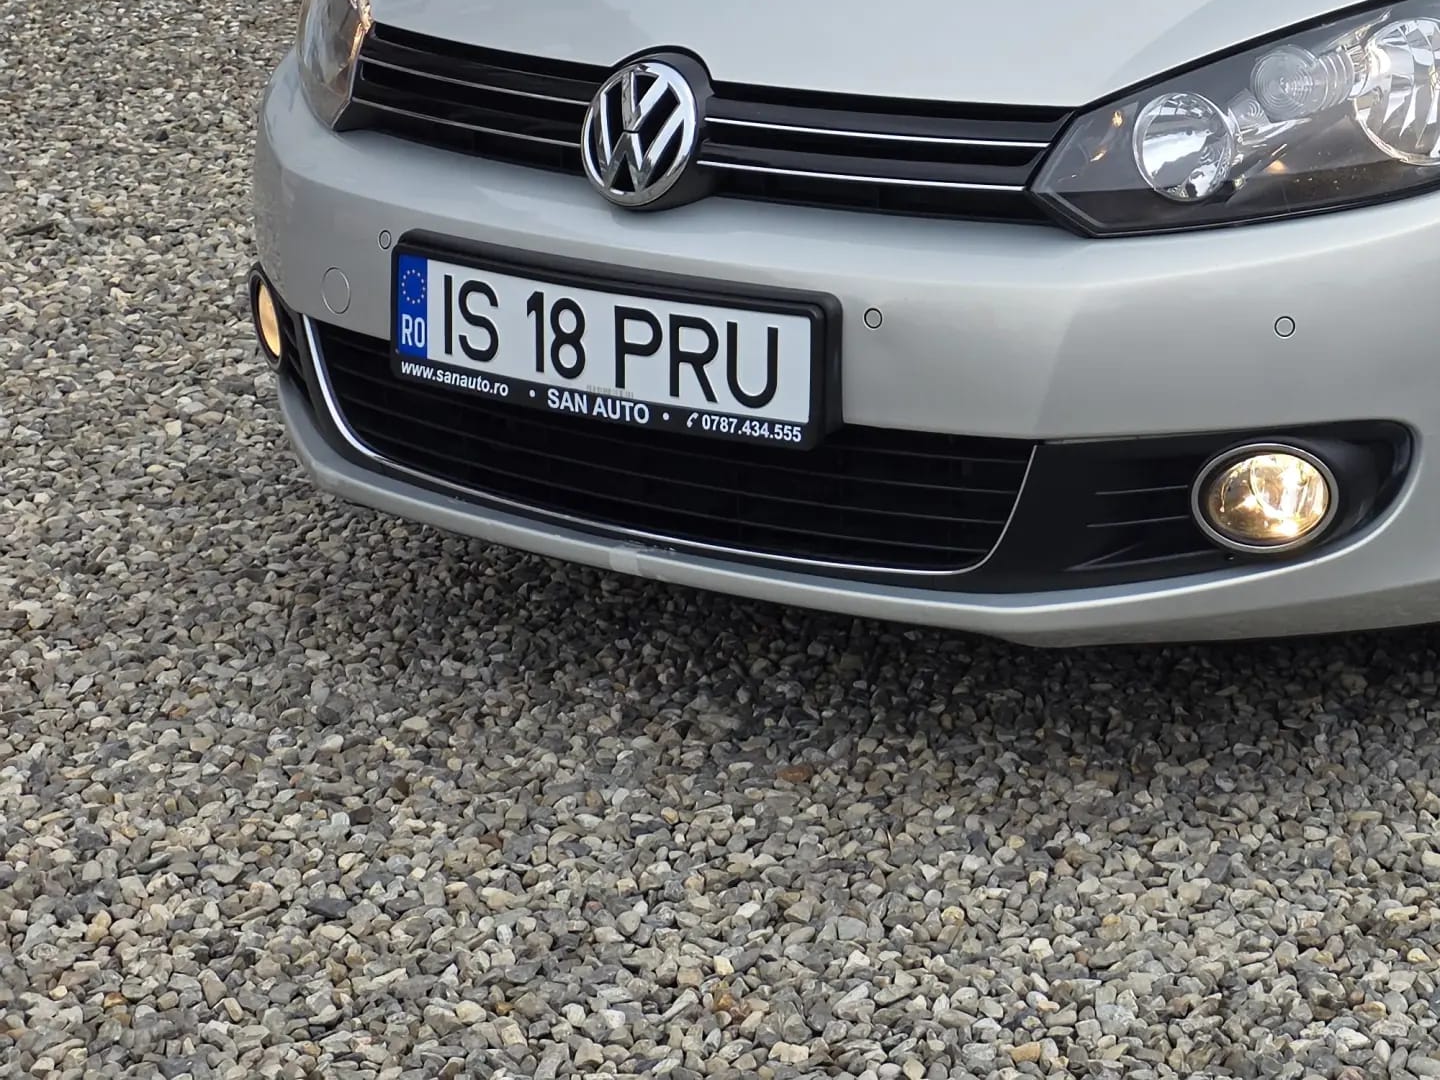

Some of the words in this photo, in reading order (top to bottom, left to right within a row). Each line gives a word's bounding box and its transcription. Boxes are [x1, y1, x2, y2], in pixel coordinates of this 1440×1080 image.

[400, 313, 427, 349] RO
[443, 274, 500, 363] IS
[525, 291, 587, 381] 18
[613, 305, 780, 410] PRU
[400, 361, 510, 398] www.sanauto.ro
[546, 388, 588, 416] SAN
[591, 396, 650, 425] AUTO
[701, 414, 802, 443] 0787.434.555
